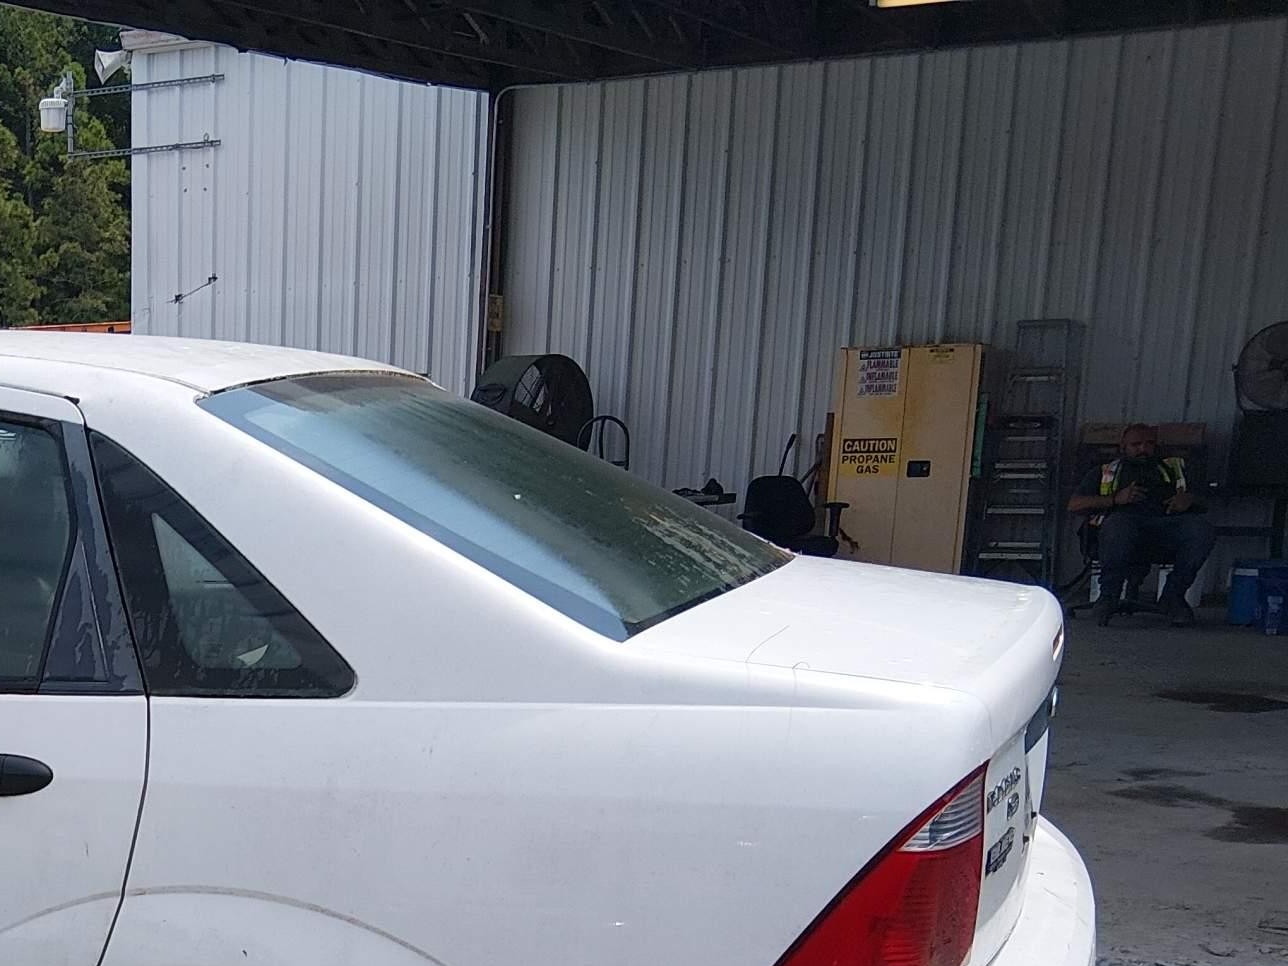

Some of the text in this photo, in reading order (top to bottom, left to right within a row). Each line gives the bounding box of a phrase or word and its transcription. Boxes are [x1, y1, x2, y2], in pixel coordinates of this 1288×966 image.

[844, 439, 896, 452] CAUTION
[841, 454, 896, 464] PROPANE
[856, 464, 880, 474] GAS
